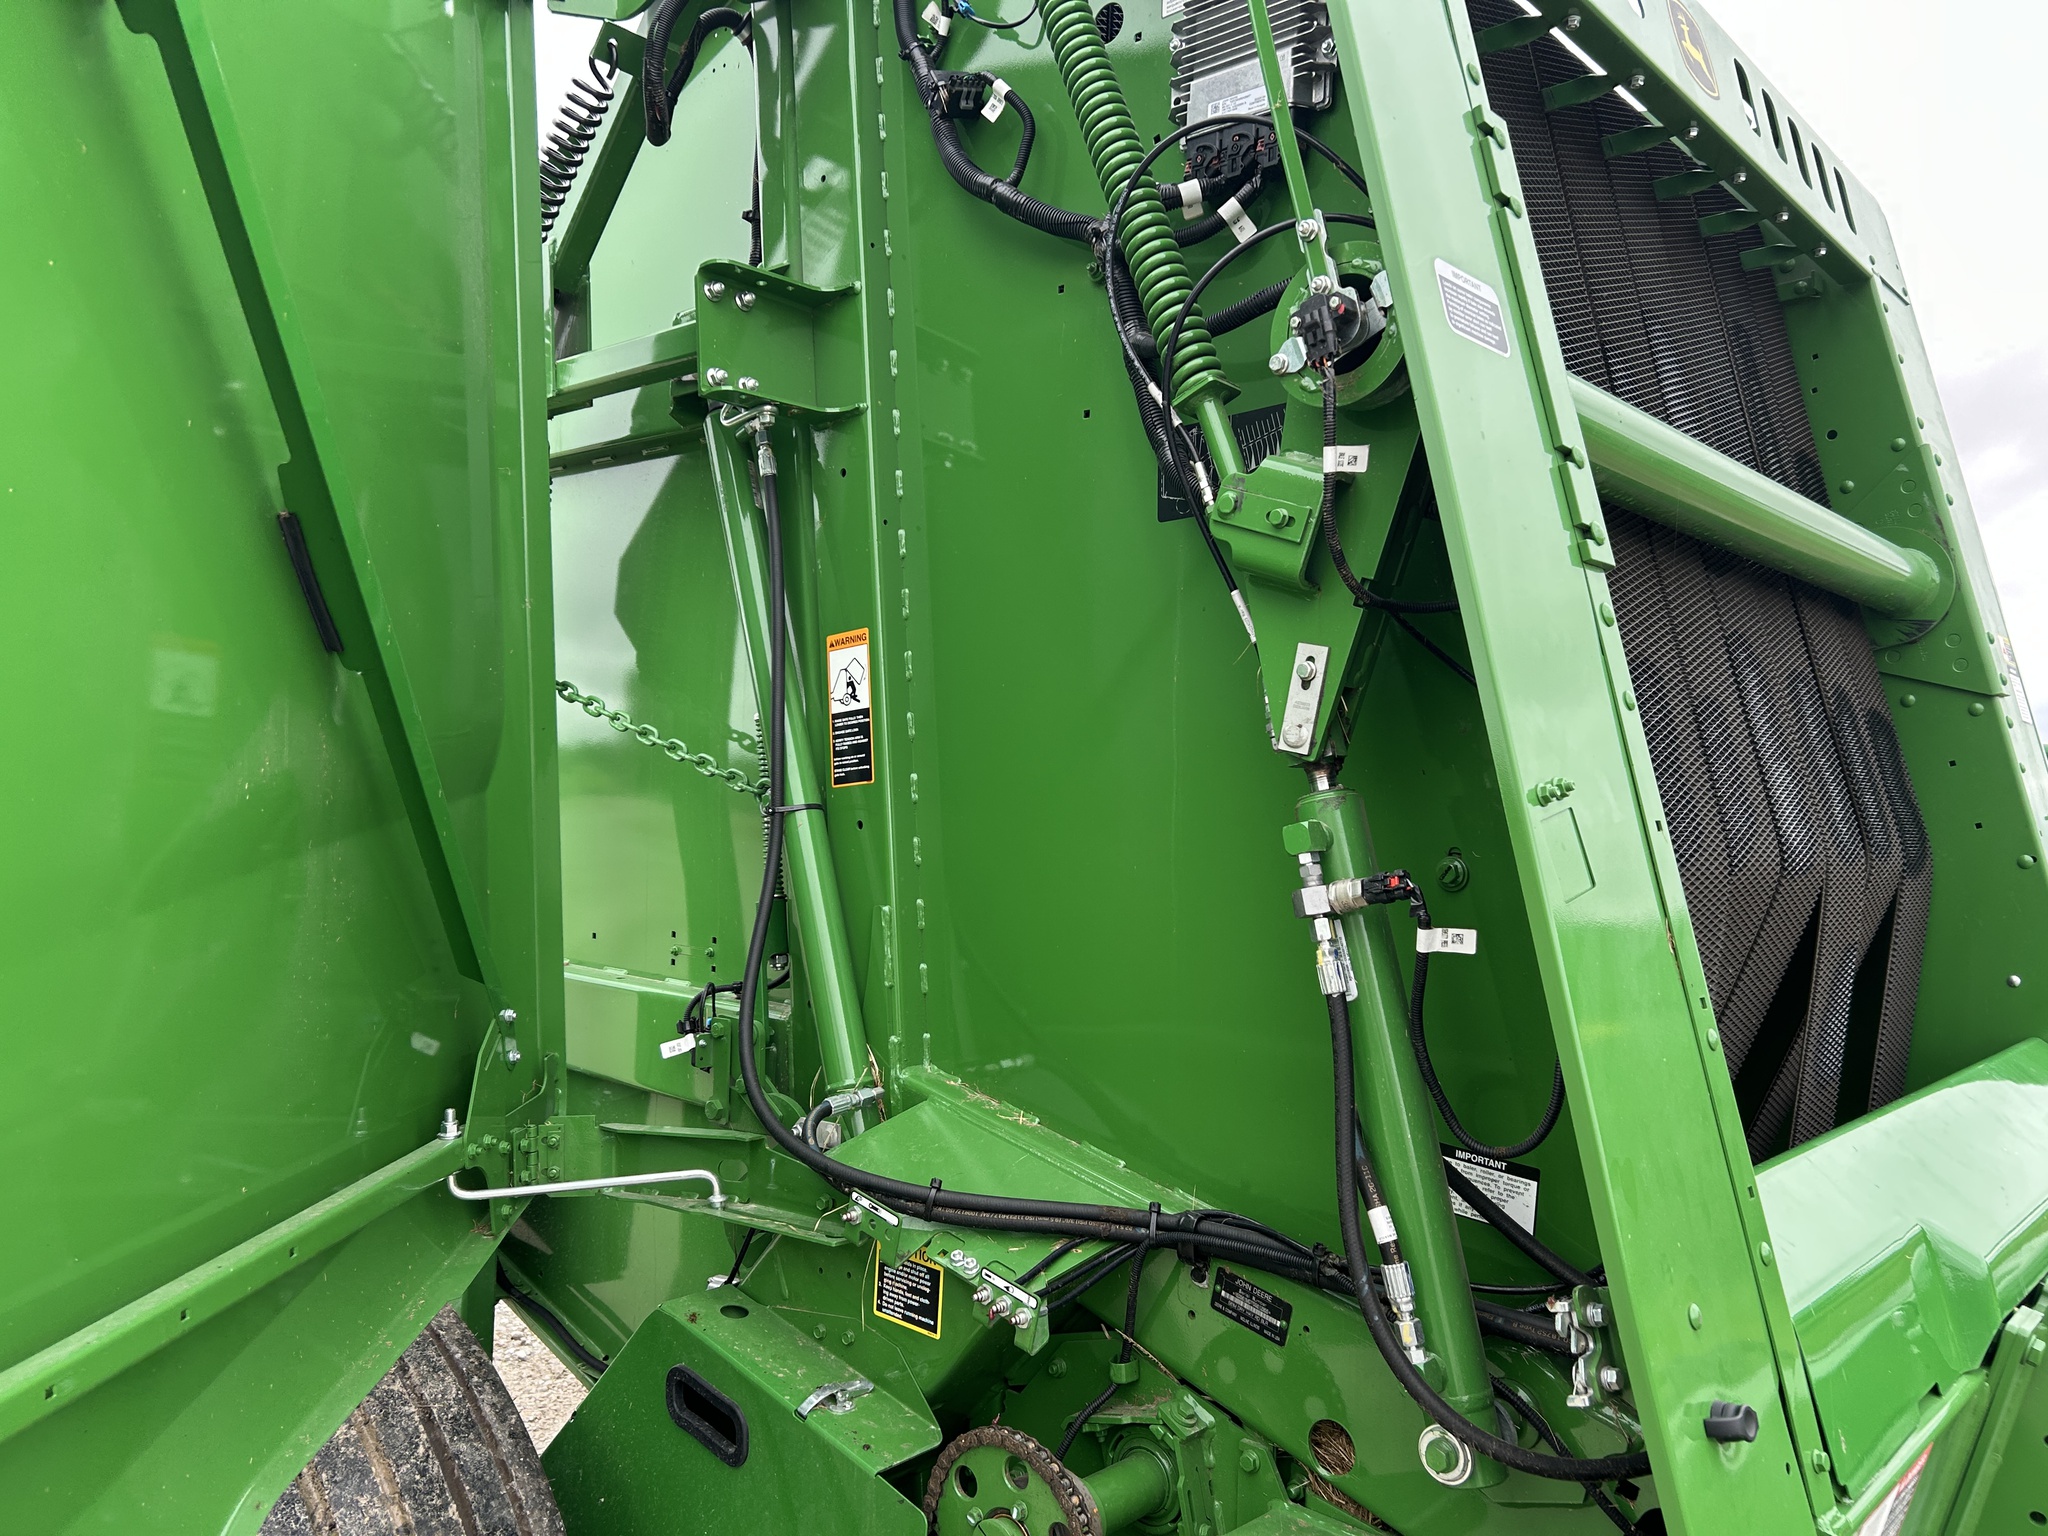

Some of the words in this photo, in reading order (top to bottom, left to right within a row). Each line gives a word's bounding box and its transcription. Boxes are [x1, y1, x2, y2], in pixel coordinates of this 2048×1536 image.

[834, 633, 867, 646] WARNING
[1455, 1149, 1507, 1171] IMPORTANT
[1235, 1278, 1252, 1291] JOHN
[1252, 1287, 1273, 1303] DEERE
